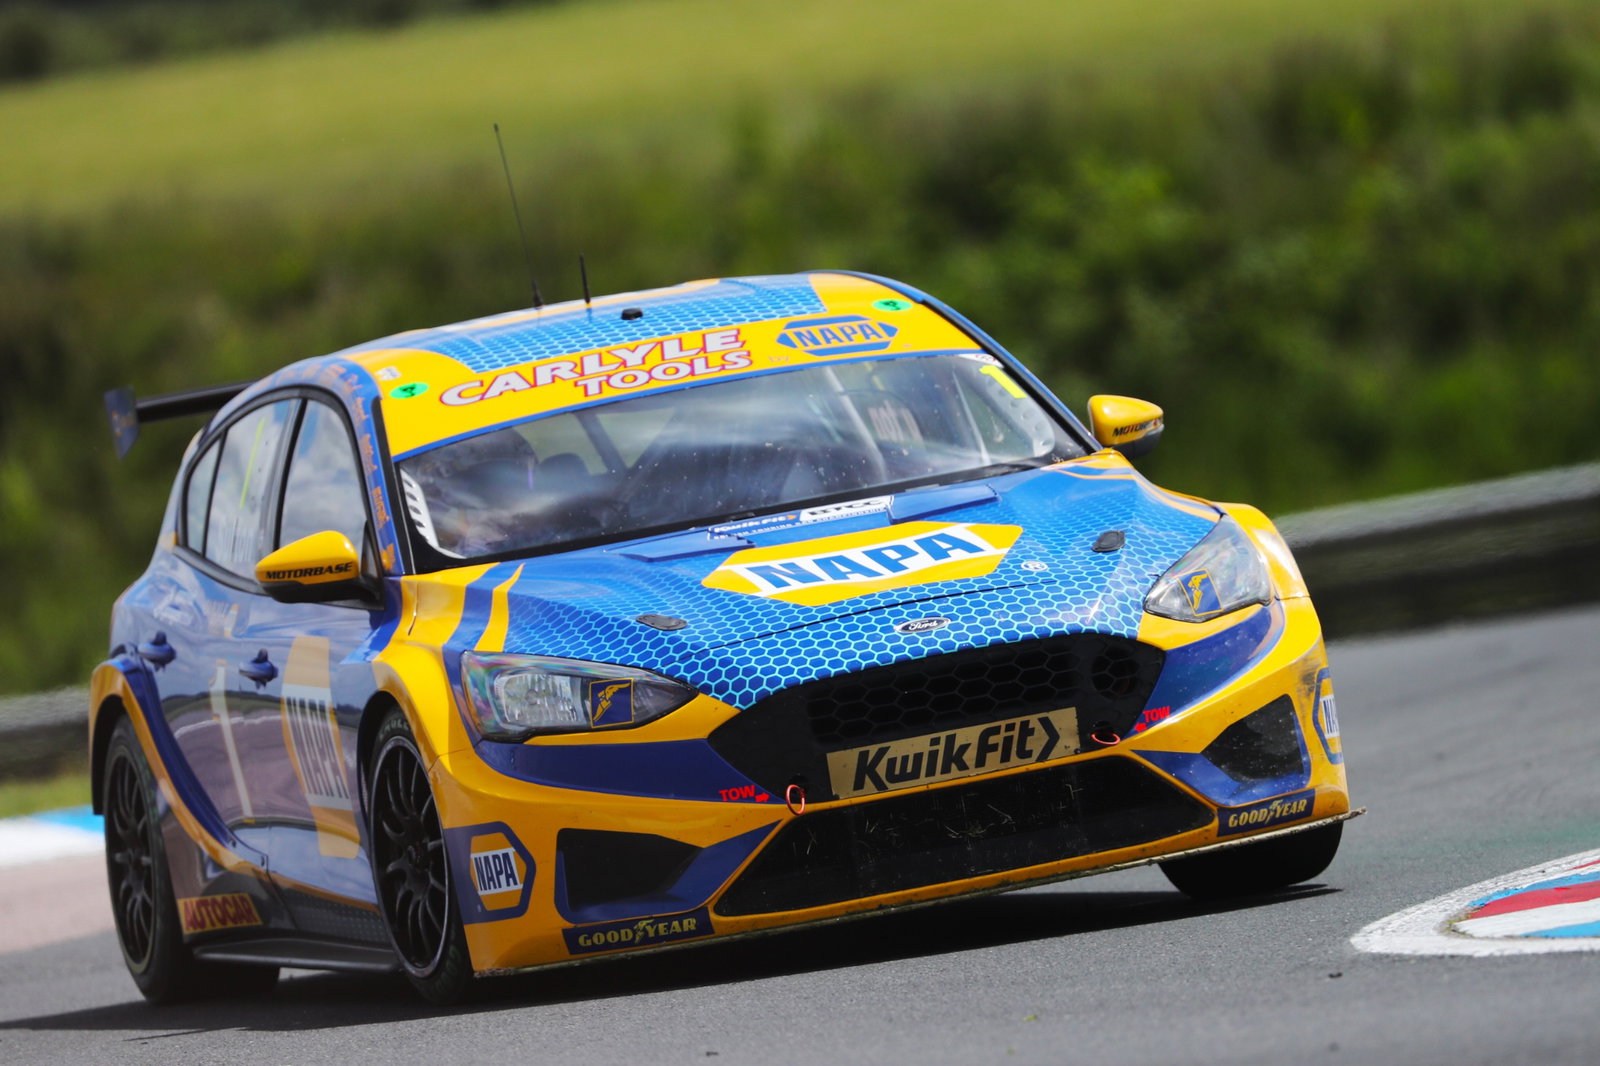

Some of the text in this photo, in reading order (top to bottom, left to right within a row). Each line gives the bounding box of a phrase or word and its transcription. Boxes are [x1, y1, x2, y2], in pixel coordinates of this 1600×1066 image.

[793, 323, 884, 347] NAPA
[440, 328, 746, 406] CARLYLE
[575, 350, 752, 397] TOOLS
[265, 562, 353, 580] MOTORBASE
[745, 533, 984, 589] NAPA
[908, 620, 938, 630] Ford
[1143, 706, 1171, 722] TOW
[720, 785, 755, 801] TOW
[474, 852, 518, 892] NAPA
[183, 894, 260, 932] AUTOCAR
